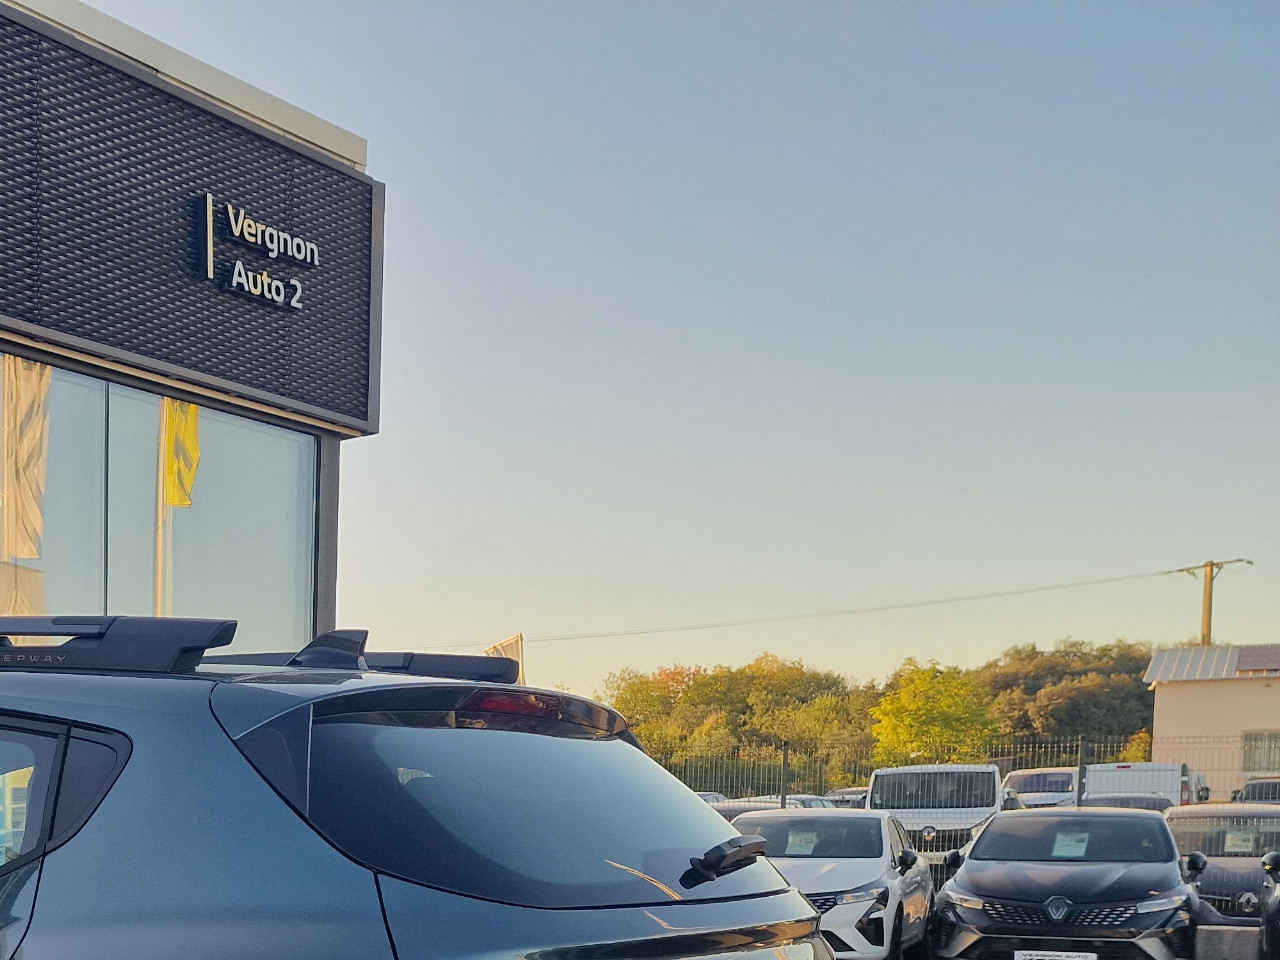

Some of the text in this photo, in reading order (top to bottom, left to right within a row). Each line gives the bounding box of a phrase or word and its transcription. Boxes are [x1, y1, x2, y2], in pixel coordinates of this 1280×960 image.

[227, 204, 320, 266] Vergnon
[231, 260, 303, 309] Auto 2
